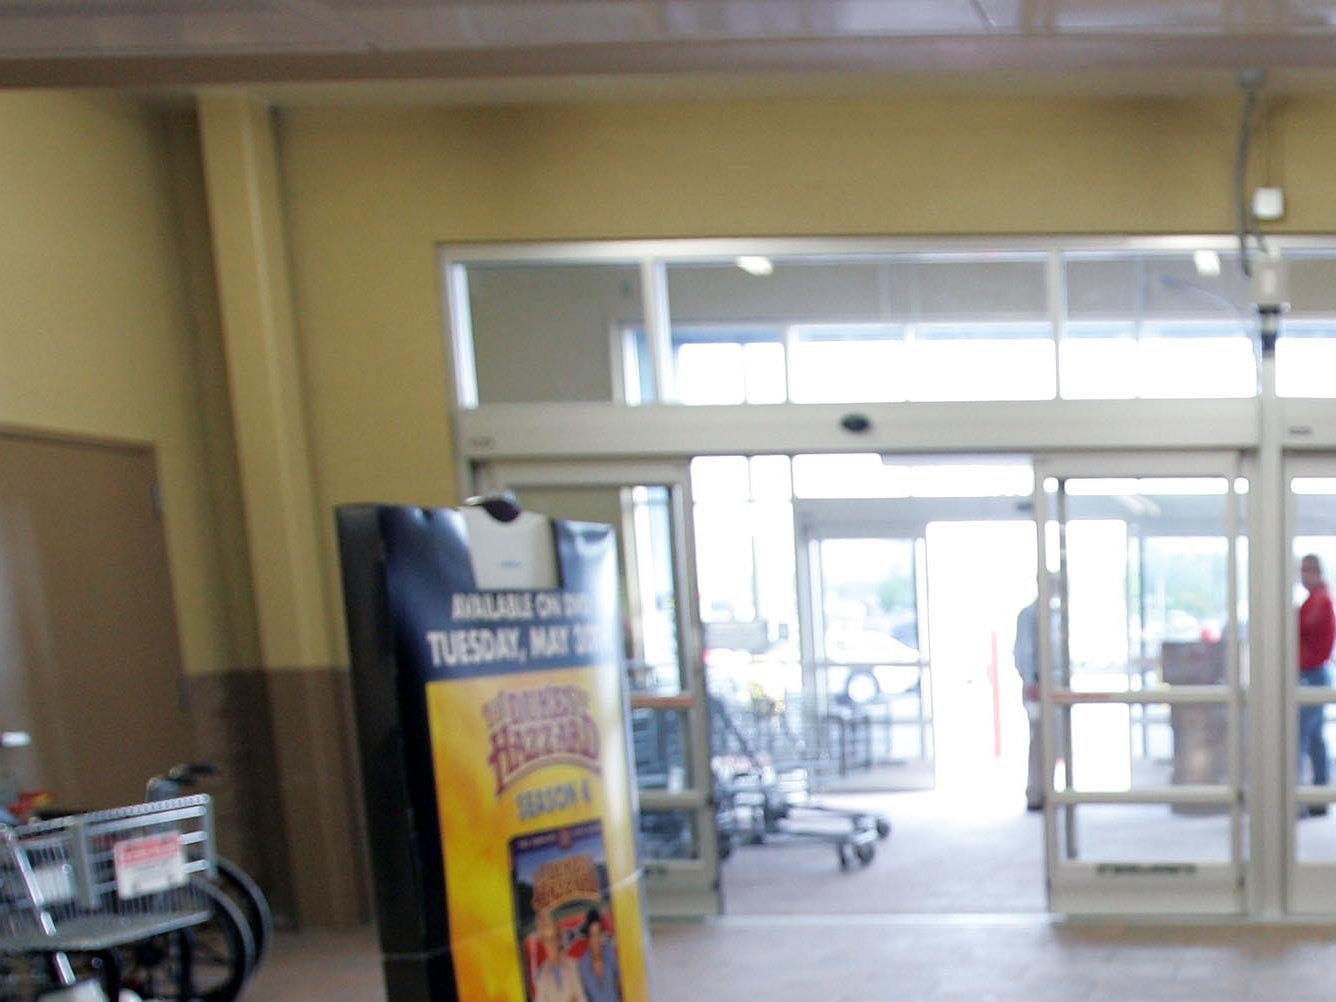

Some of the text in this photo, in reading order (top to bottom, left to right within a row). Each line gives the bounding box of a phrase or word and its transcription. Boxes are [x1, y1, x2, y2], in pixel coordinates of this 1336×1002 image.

[451, 592, 533, 622] AVAILABLE
[535, 592, 561, 617] ON
[529, 625, 571, 658] MAY
